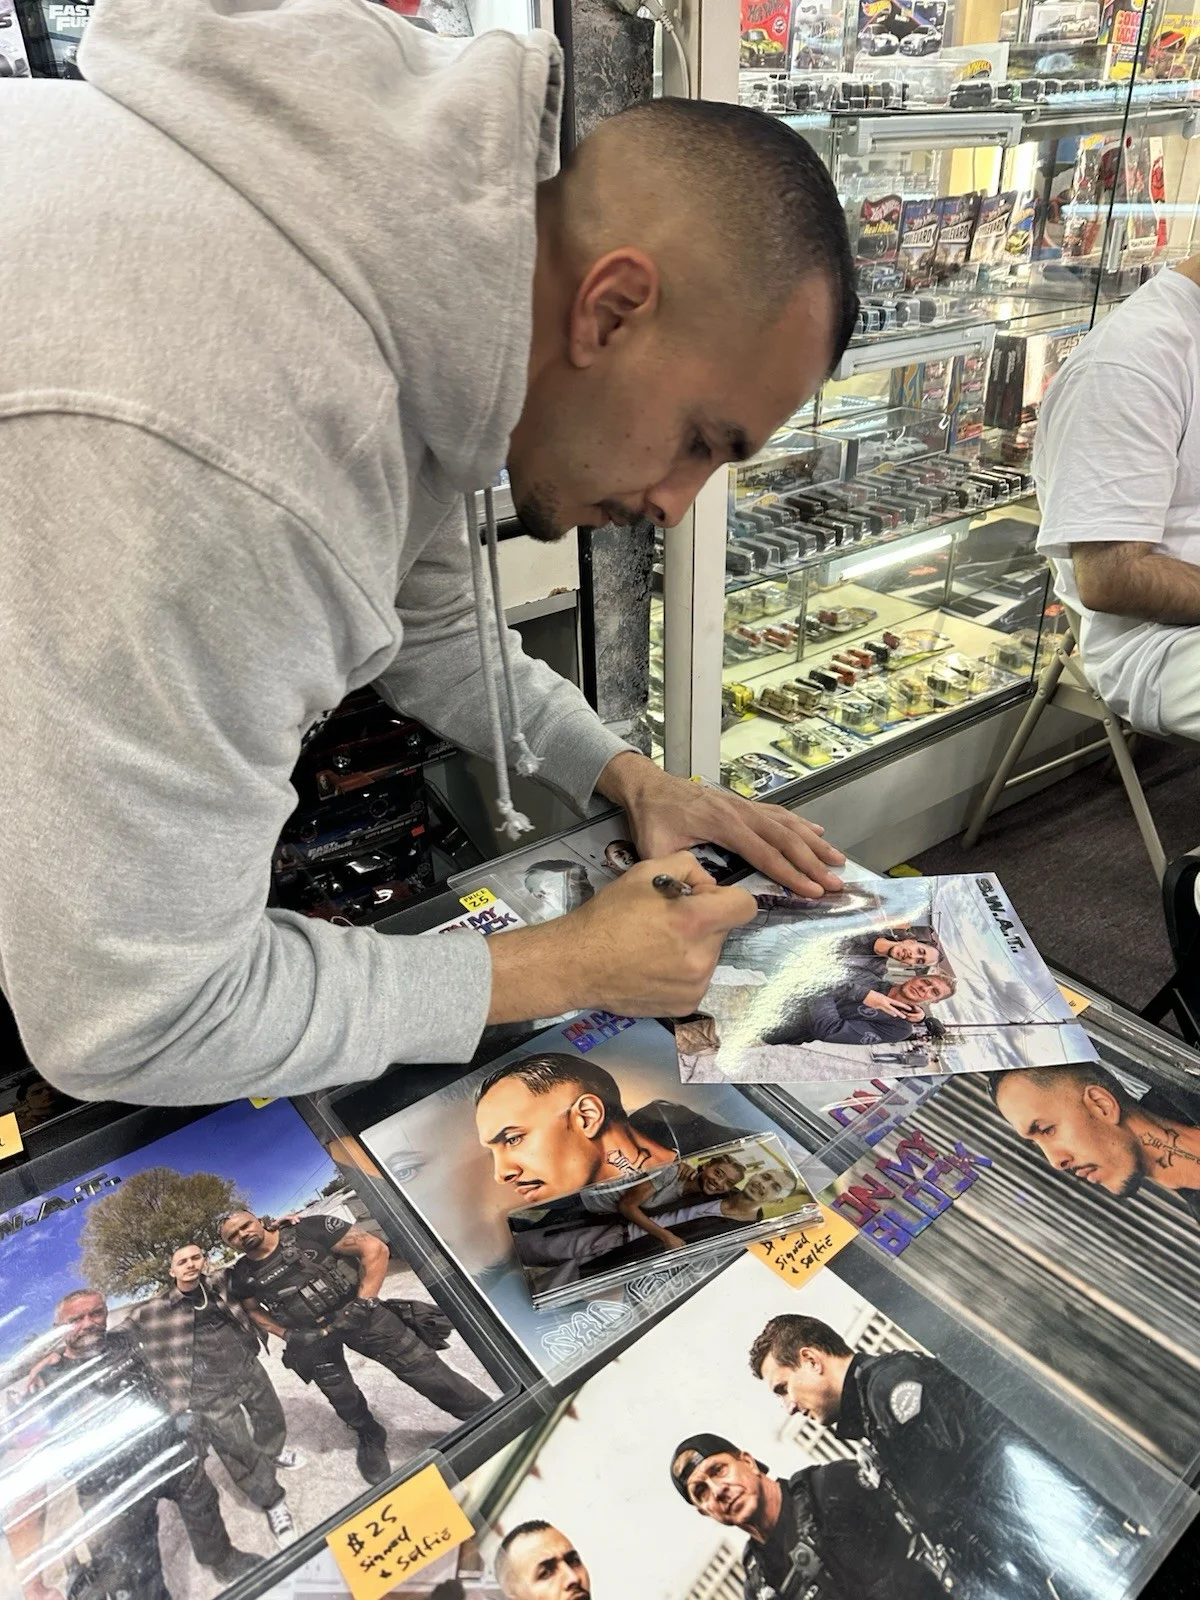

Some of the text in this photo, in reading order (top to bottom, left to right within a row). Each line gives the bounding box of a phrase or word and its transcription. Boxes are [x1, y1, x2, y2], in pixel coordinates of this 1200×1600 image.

[463, 889, 488, 903] PRICE
[469, 895, 490, 908] 25
[467, 906, 497, 927] MY
[976, 877, 1026, 953] S.W.A.T.
[561, 1019, 595, 1042] ON
[830, 1173, 897, 1228] ON
[875, 1129, 939, 1189] MY
[862, 1140, 993, 1258] BLOCK
